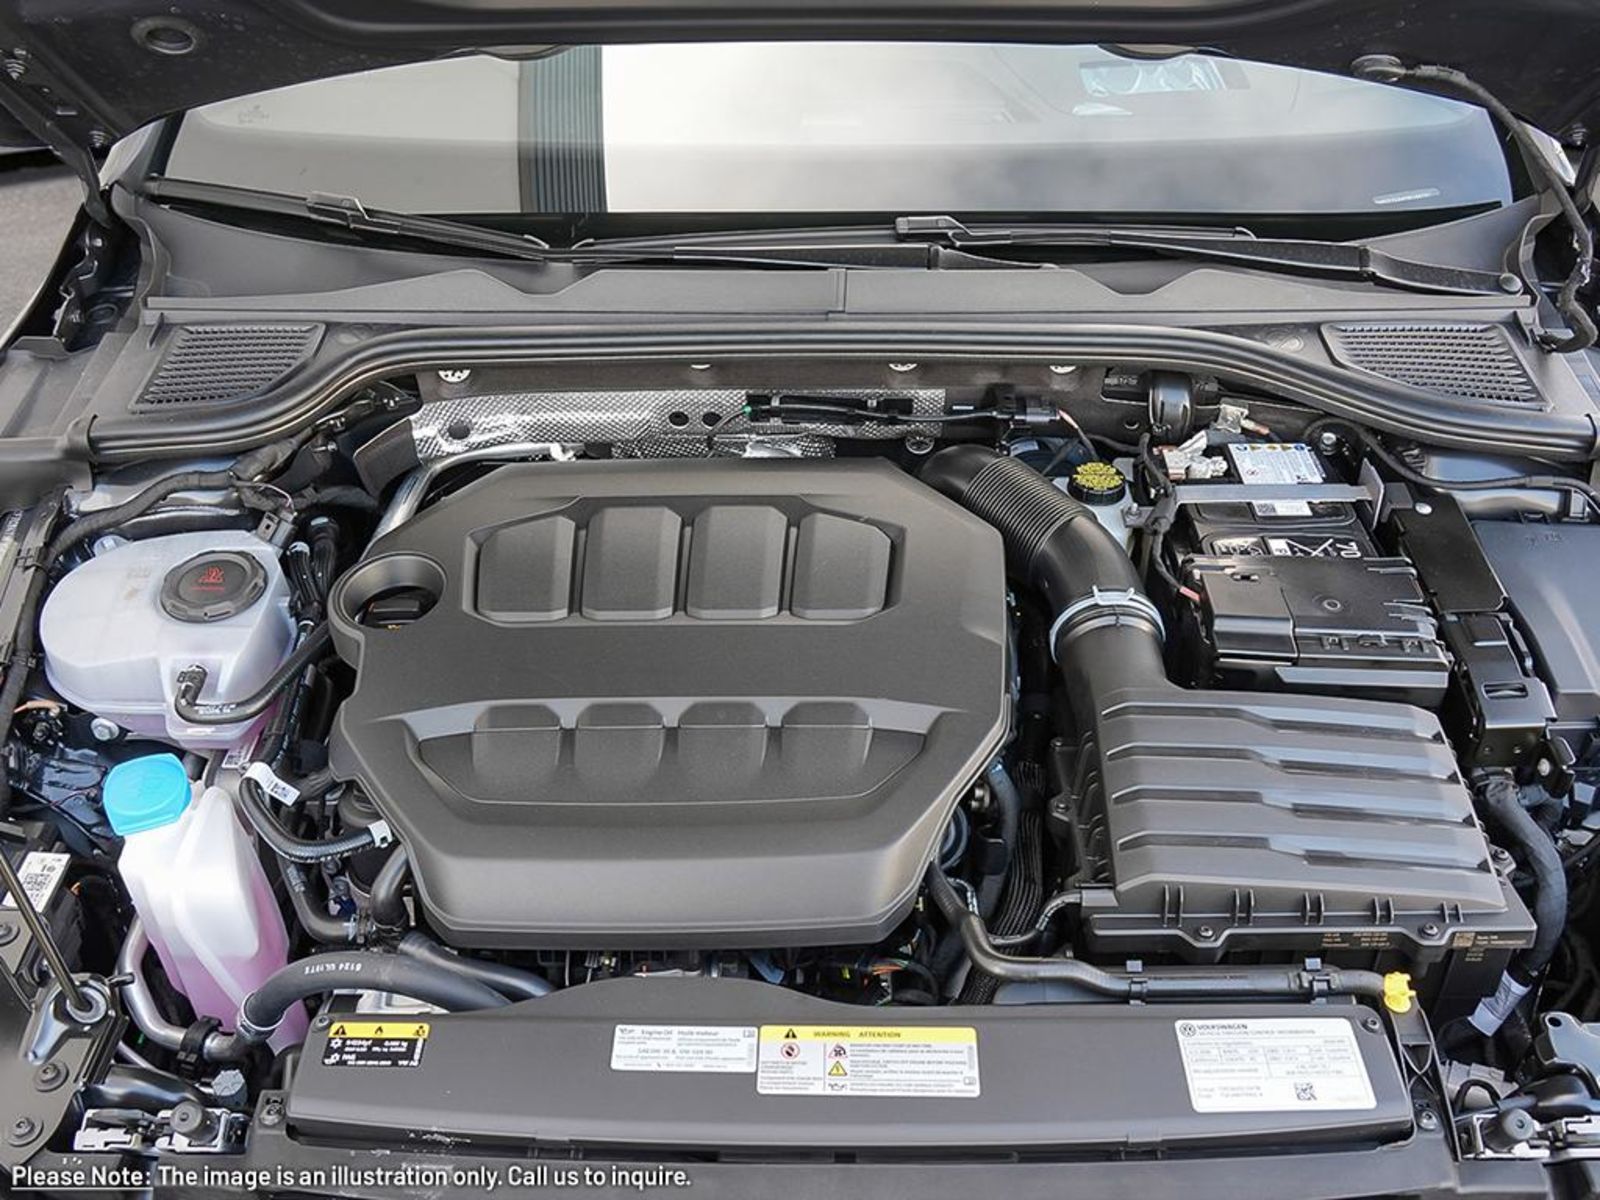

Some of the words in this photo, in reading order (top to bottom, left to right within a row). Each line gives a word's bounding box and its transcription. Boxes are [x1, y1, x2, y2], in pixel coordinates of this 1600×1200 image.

[1197, 1023, 1248, 1031] VOLKSWAGEN
[813, 1030, 851, 1038] WARNING
[859, 1031, 901, 1039] ATTENTION
